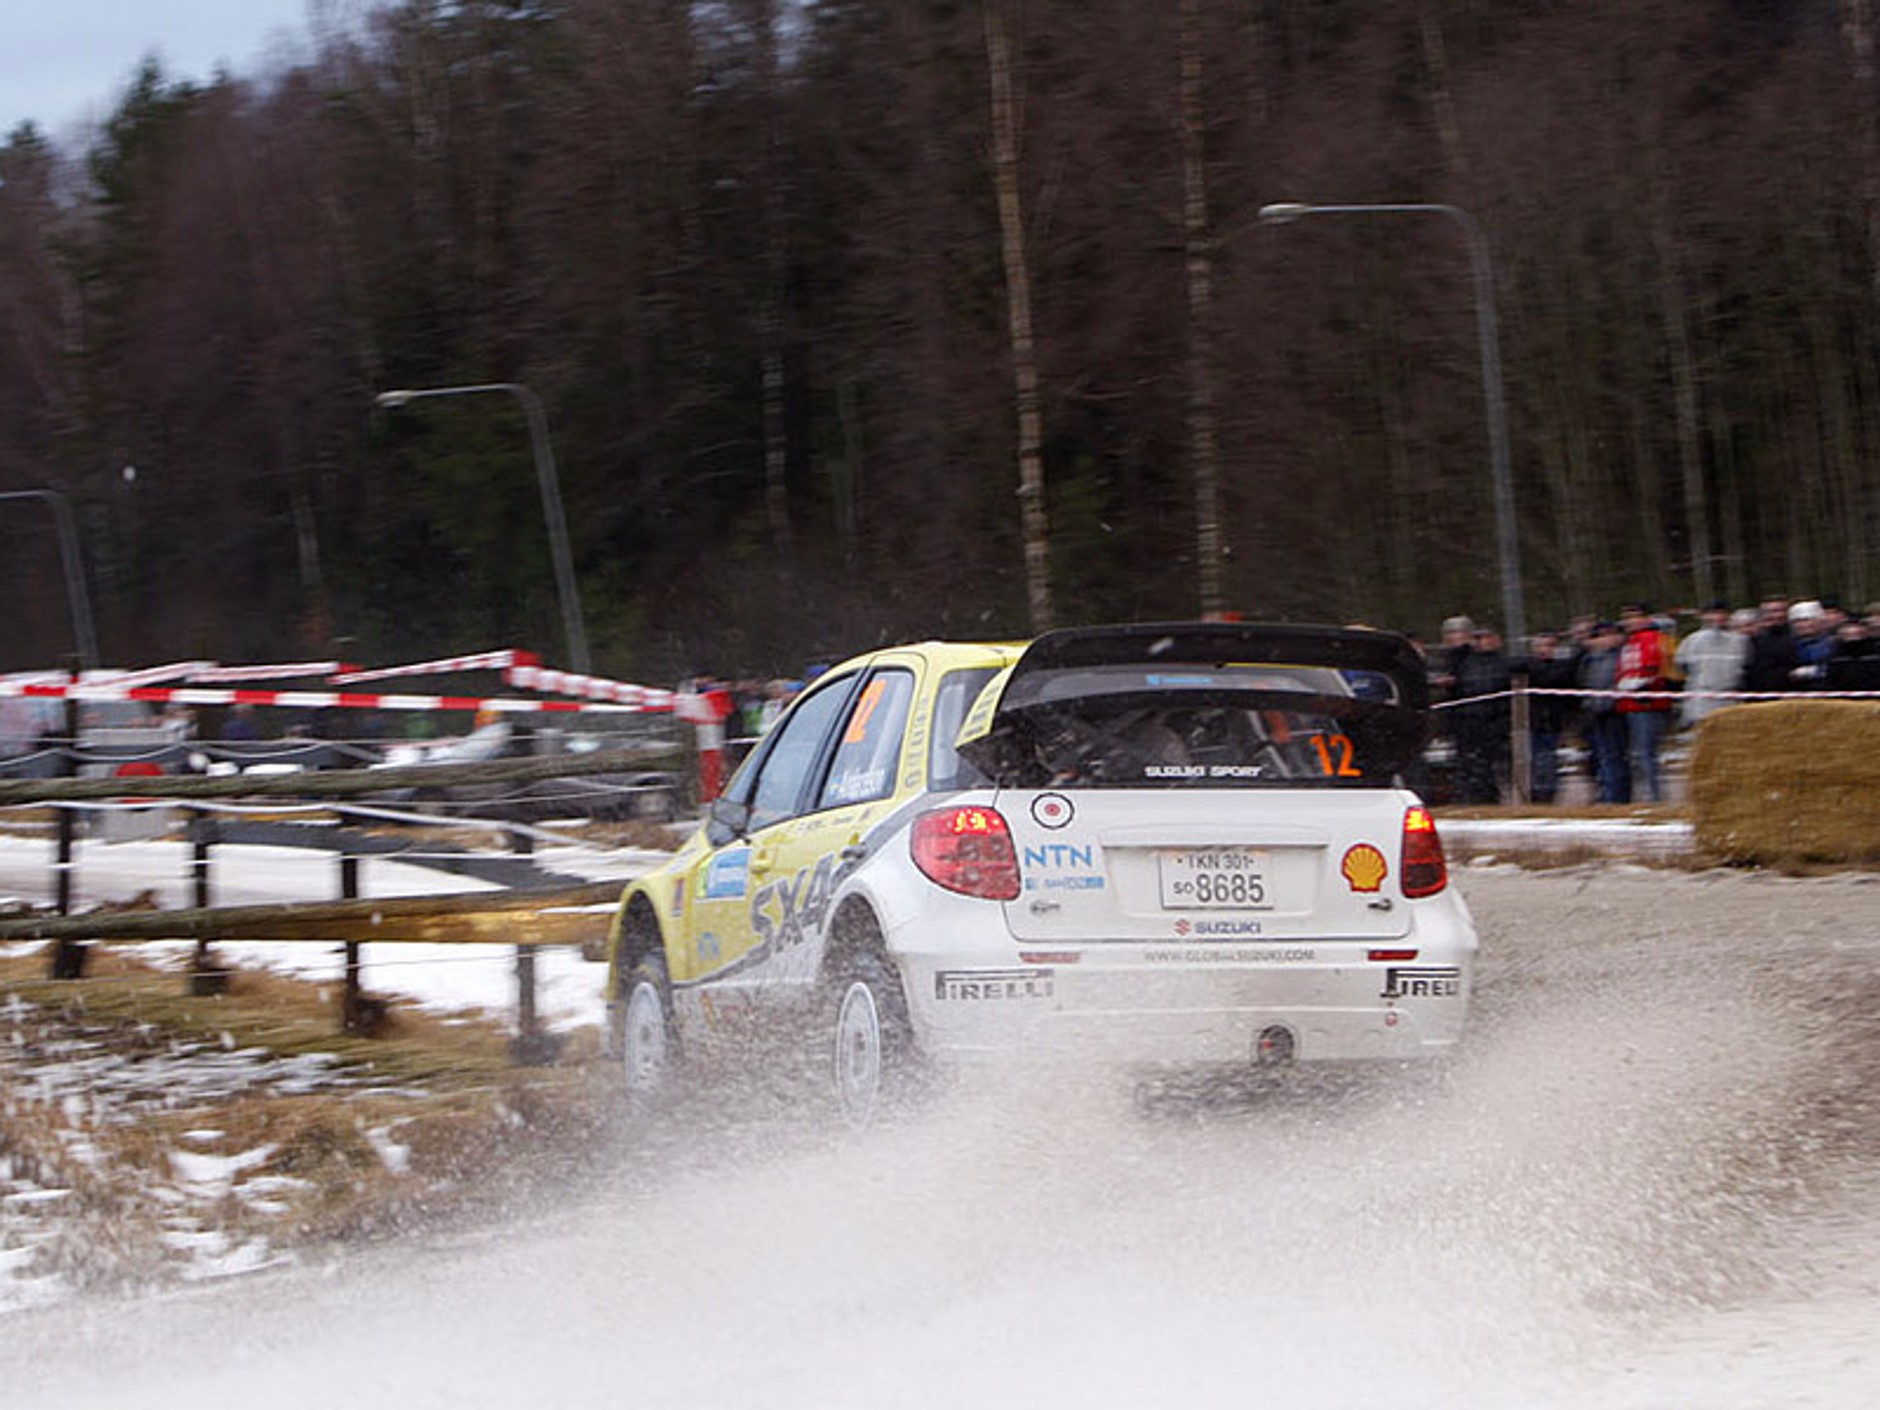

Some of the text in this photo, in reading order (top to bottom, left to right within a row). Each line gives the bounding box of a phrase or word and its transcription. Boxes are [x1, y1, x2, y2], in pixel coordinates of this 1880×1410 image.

[1310, 734, 1362, 777] 12
[1144, 765, 1263, 777] SUZUKI SPORT
[1024, 844, 1093, 868] NTN
[1195, 873, 1265, 903] 8685
[1194, 921, 1262, 934] SUZUKI
